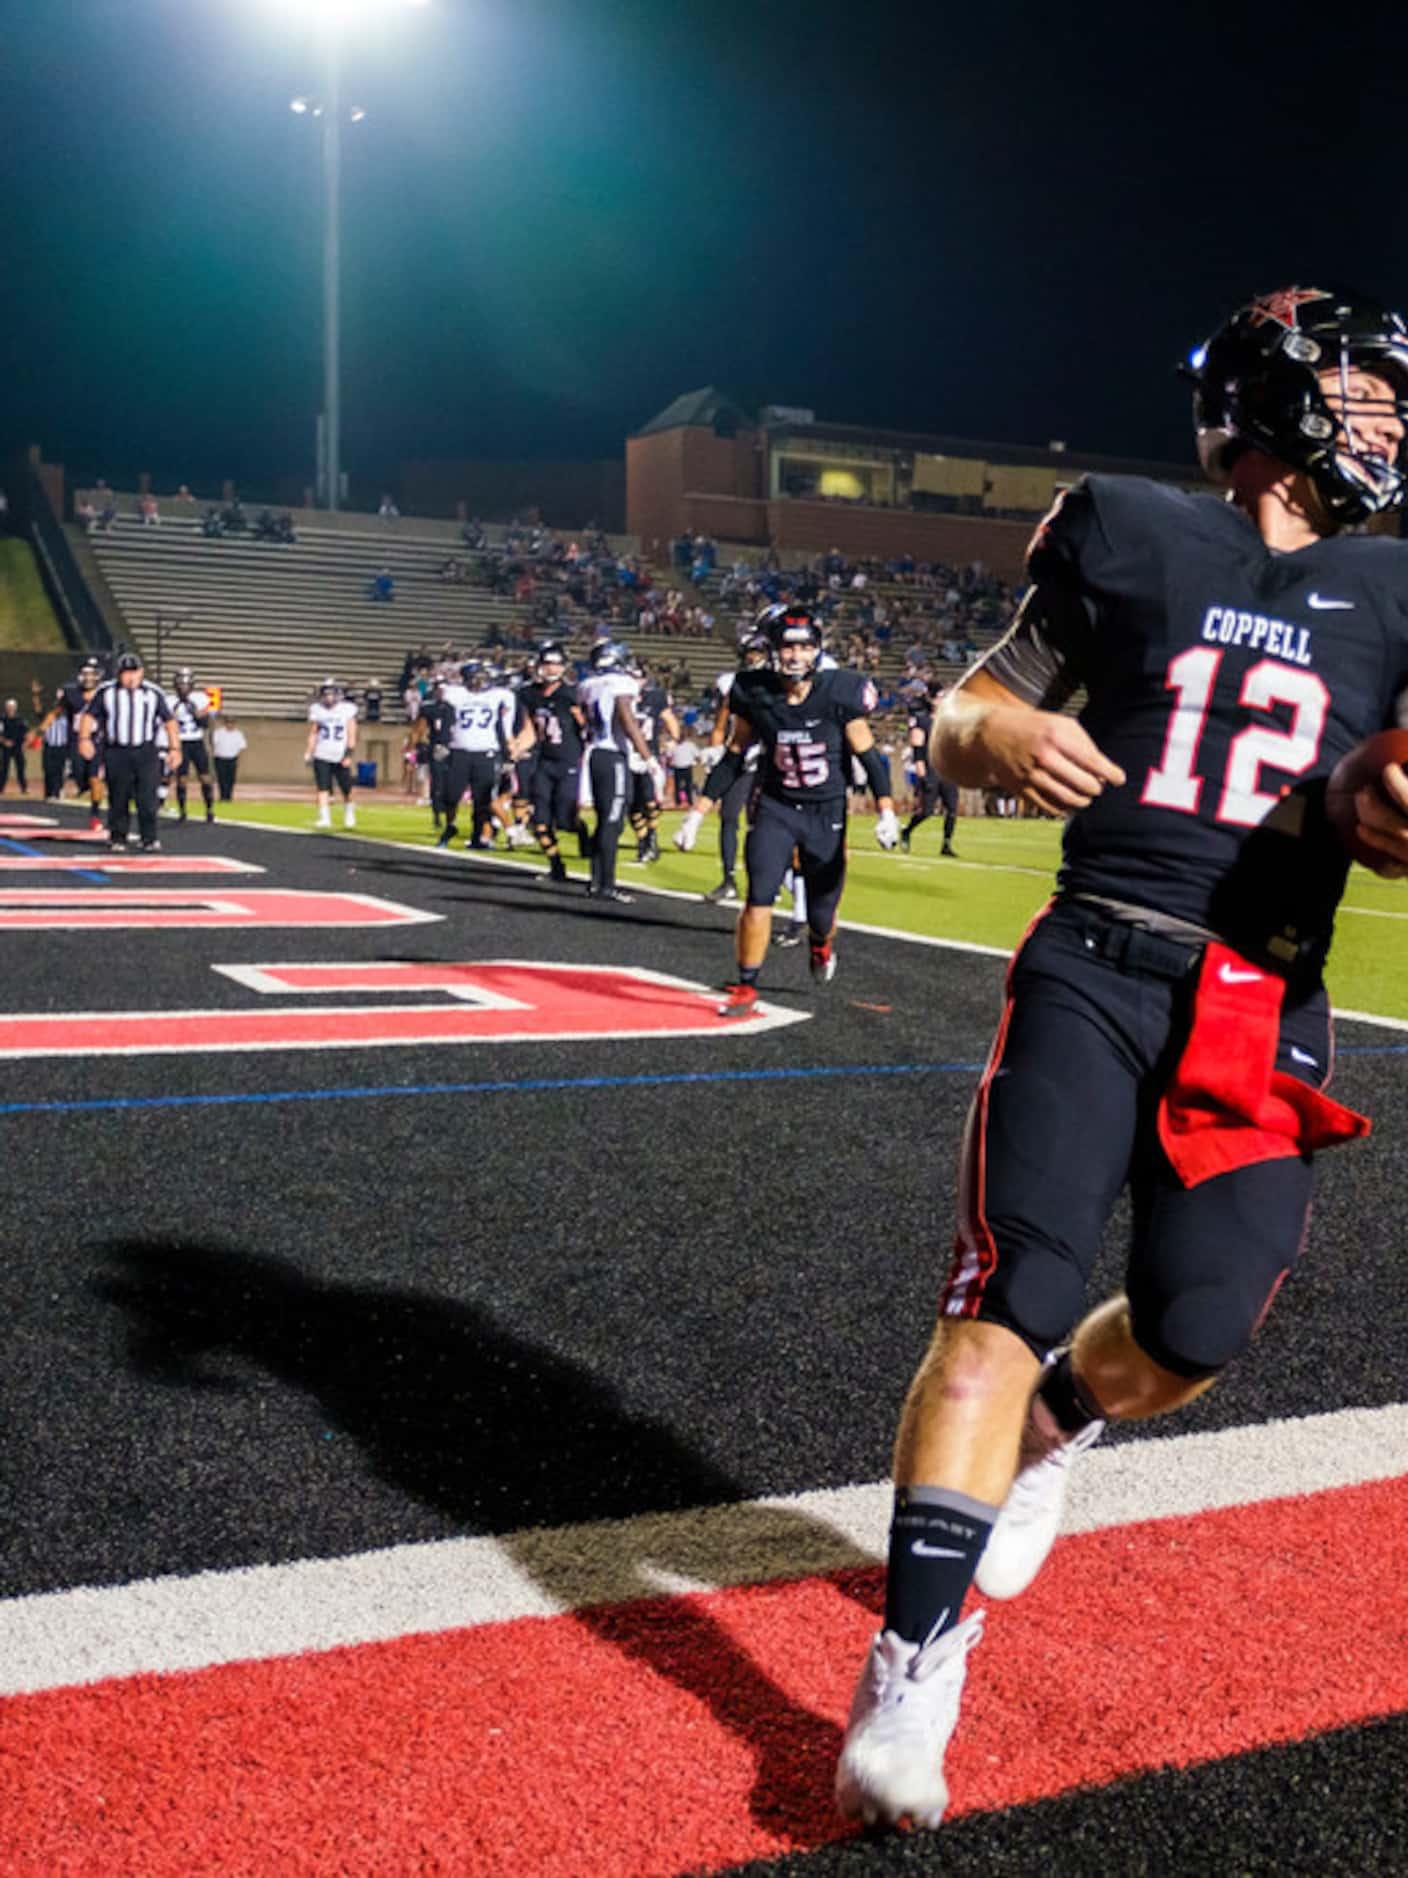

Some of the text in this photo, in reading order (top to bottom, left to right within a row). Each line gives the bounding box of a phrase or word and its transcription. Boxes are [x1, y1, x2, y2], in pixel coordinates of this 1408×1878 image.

[1202, 606, 1312, 665] COPPELL
[459, 708, 493, 729] 53
[1139, 644, 1332, 829] 12
